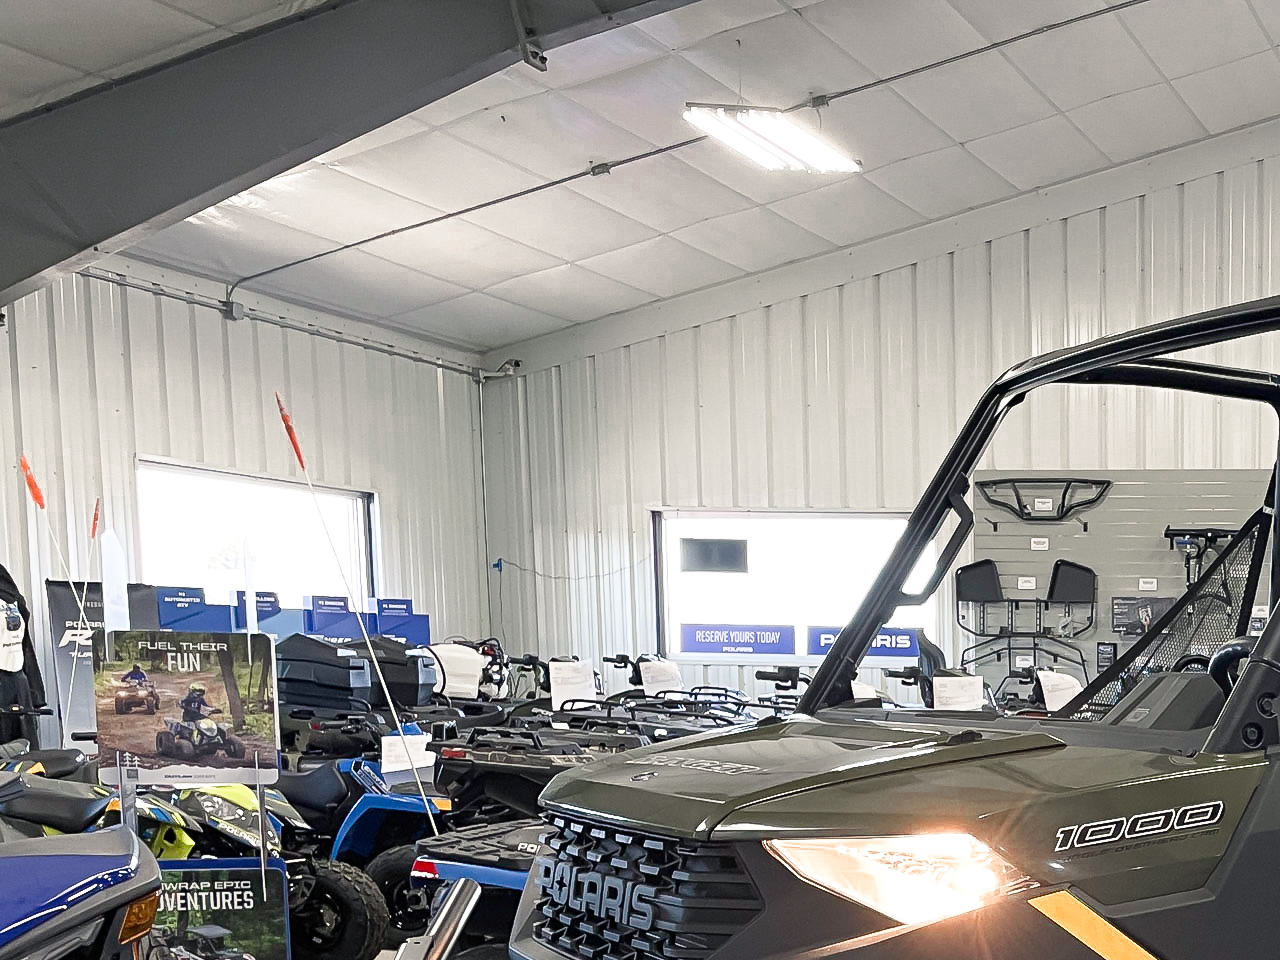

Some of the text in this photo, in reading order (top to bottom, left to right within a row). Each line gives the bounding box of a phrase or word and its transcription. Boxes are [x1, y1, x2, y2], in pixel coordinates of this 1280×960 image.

[138, 641, 228, 651] FUEL THEIR
[695, 630, 781, 644] RESERVE YOURS TODAY
[819, 633, 911, 649] PRIS
[167, 652, 201, 672] FUN
[1054, 800, 1224, 852] 1000
[161, 881, 251, 890] WRAP EPIC
[535, 855, 655, 931] POLARIS
[157, 890, 254, 911] VENTURES
